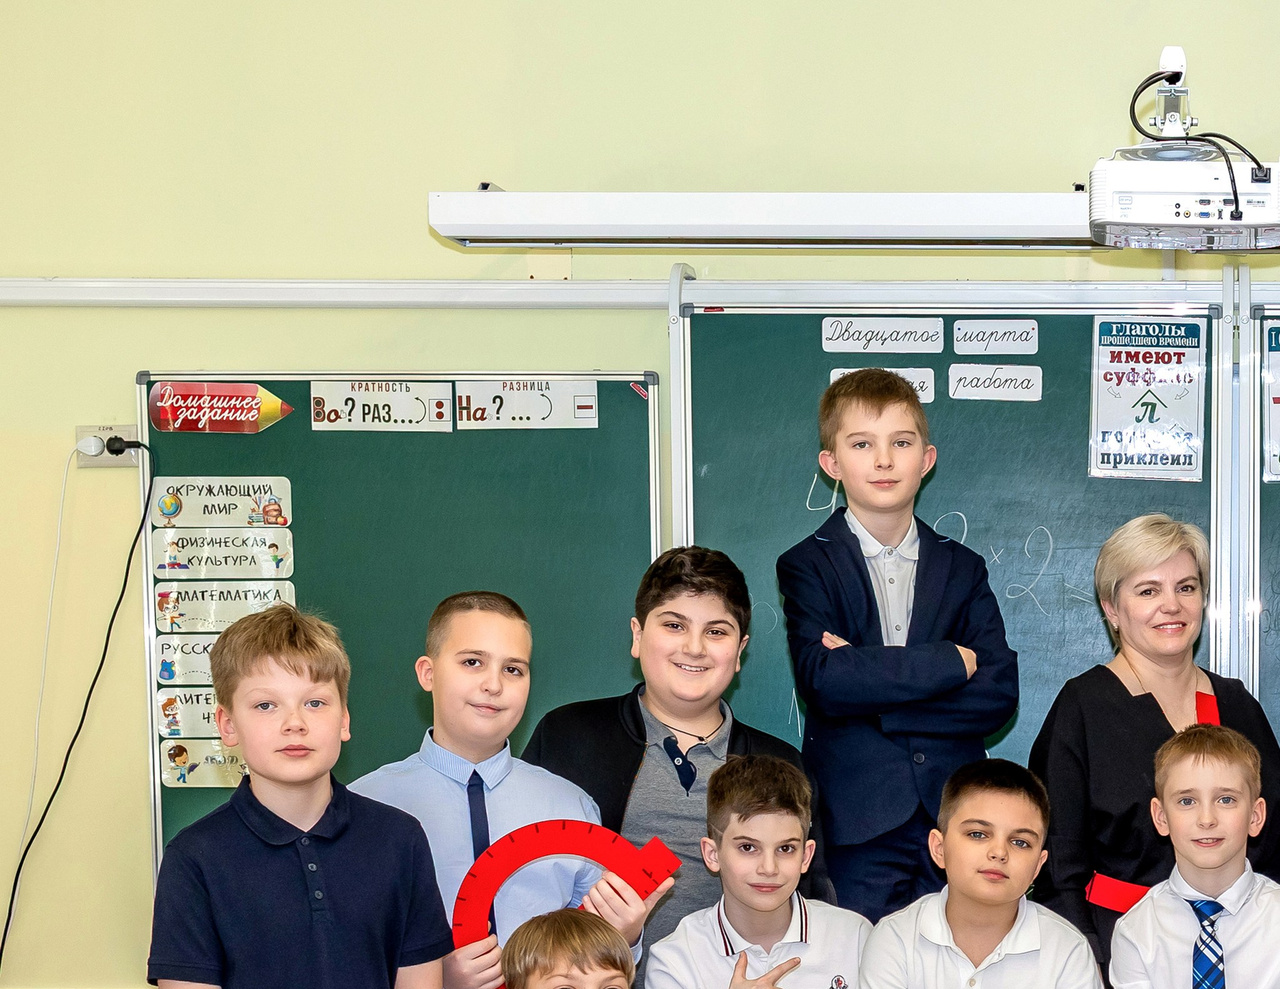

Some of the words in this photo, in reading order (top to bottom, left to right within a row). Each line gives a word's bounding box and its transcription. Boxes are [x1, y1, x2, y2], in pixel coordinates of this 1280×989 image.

[825, 320, 940, 350] Двадцатое
[956, 329, 1034, 351] марта
[1109, 350, 1186, 364] имеют
[350, 382, 411, 393] КРАТНОСТЬ
[502, 381, 551, 392] РАЗНИЦА
[952, 368, 1035, 397] работа
[156, 385, 263, 409] Домашнее
[174, 406, 260, 428] задание
[1100, 452, 1193, 468] приклеил
[166, 483, 273, 498] ОКРУЖАЮЩИЙ
[202, 503, 238, 515] МИР
[176, 536, 267, 549] ФИЗИЧЕСКАЯ
[187, 555, 257, 567] КУЛЬТУРА
[176, 589, 282, 601] МАТЕМАТИКА
[161, 642, 215, 655] РУССК
